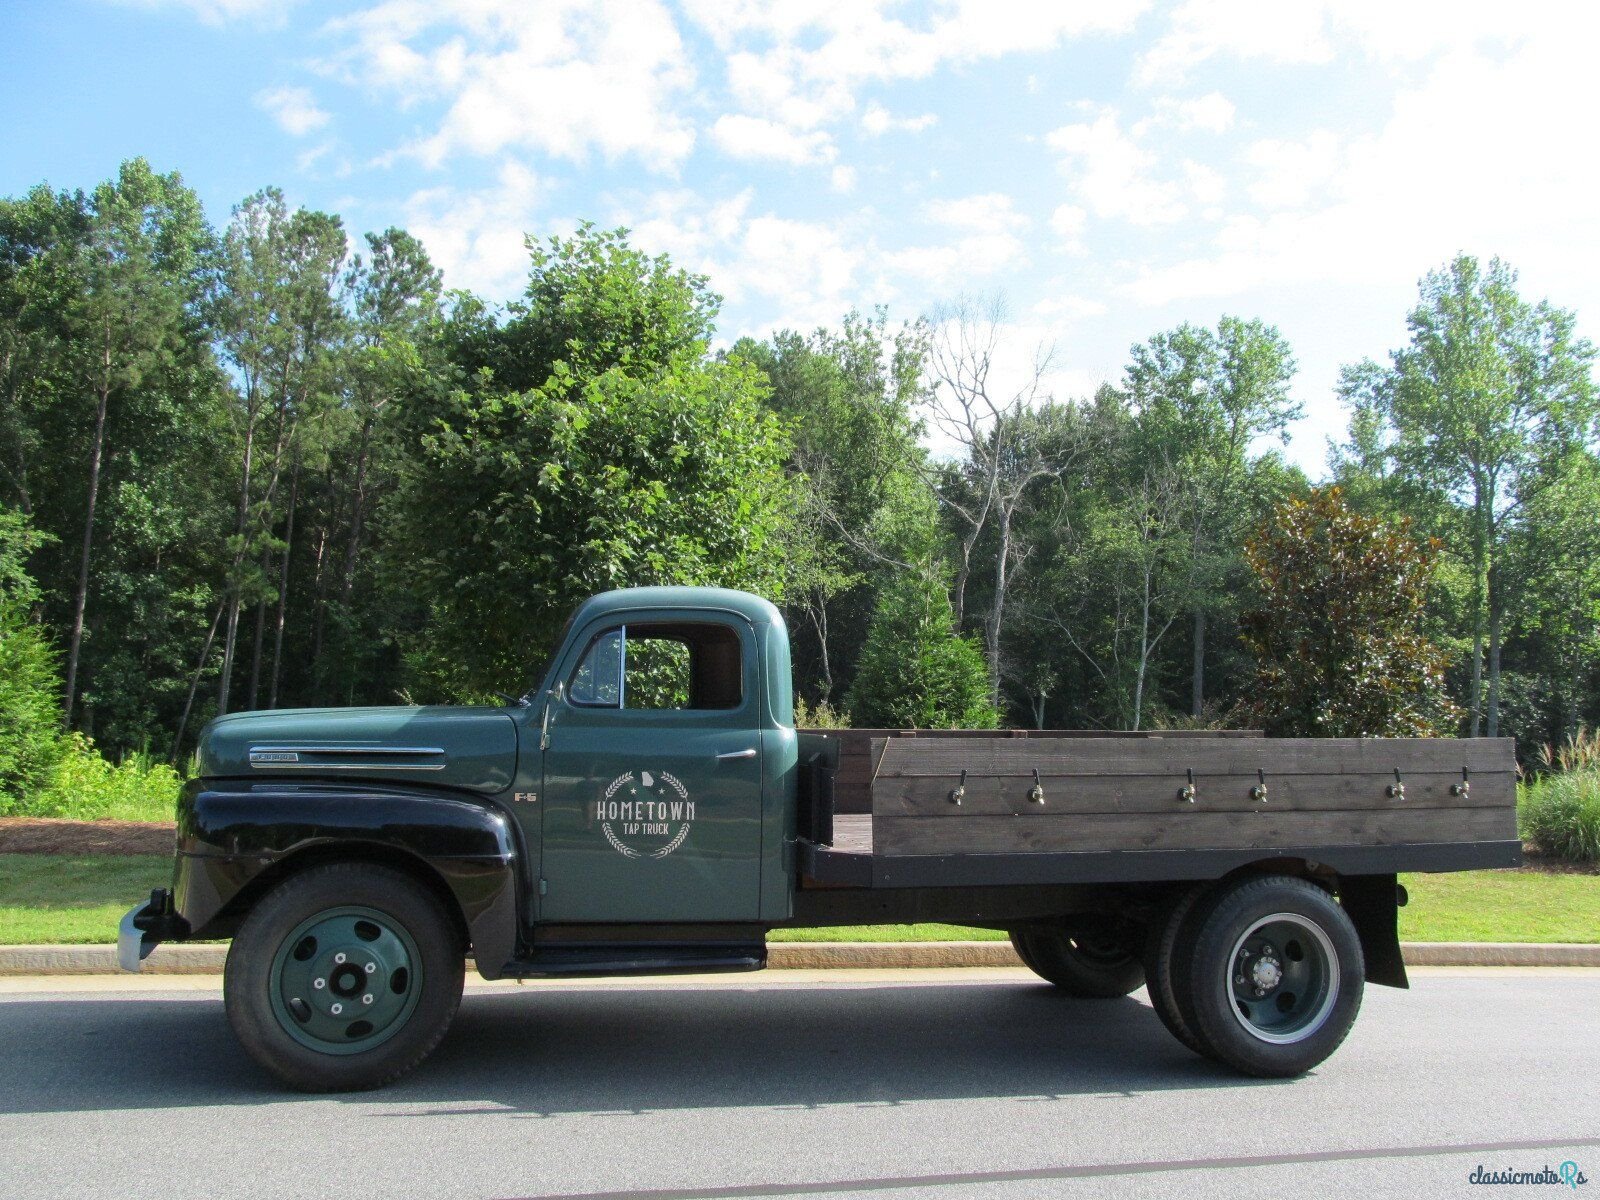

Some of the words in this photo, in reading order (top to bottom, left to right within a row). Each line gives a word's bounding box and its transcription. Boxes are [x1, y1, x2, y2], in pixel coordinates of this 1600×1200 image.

[597, 801, 695, 820] HOMETOWN
[623, 823, 639, 834] TAP
[642, 823, 668, 834] TRUCK
